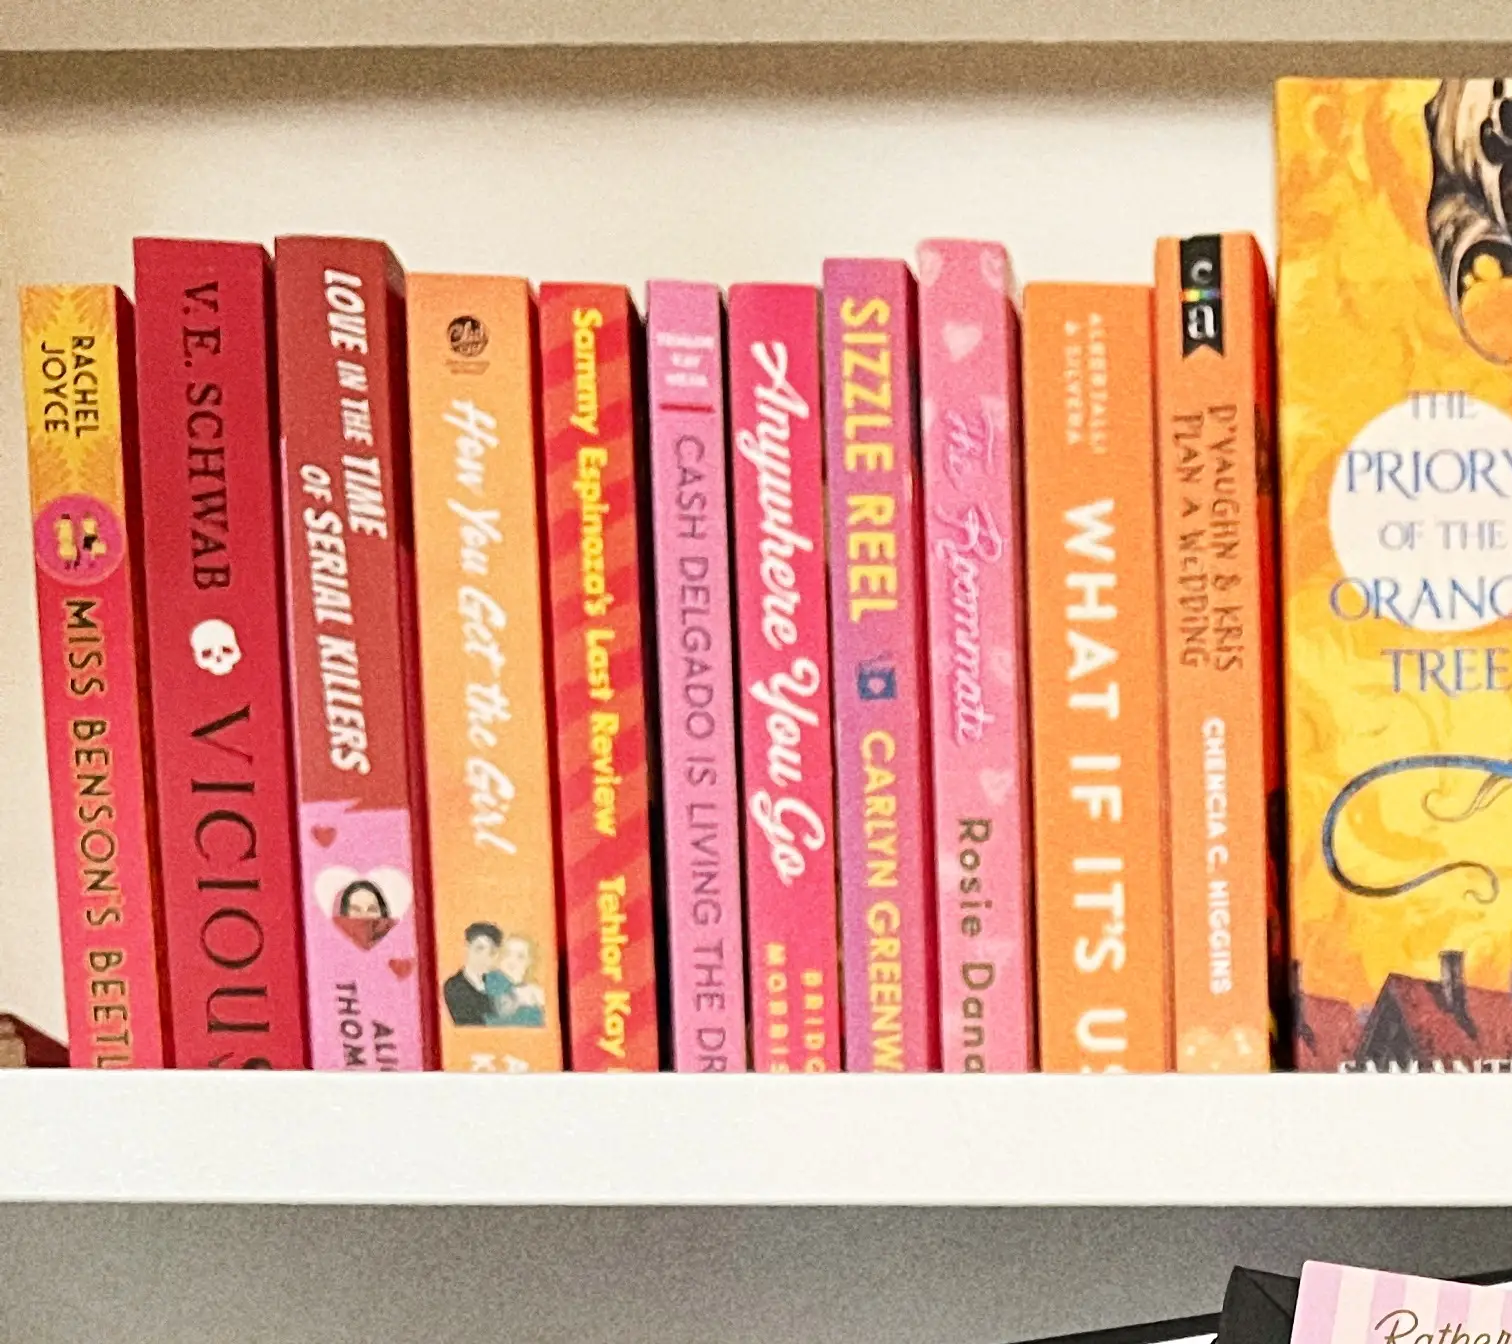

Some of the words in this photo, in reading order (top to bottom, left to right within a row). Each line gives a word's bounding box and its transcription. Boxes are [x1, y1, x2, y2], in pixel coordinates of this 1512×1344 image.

[324, 268, 368, 356] LOVE
[42, 342, 69, 434] JOYCE
[73, 336, 100, 438] RACHEL
[340, 399, 375, 447] THE
[840, 297, 896, 474] SIZZLE
[186, 383, 232, 591] SCHWAB
[300, 464, 333, 504] OF
[343, 456, 388, 540] TIME
[674, 435, 708, 539] CASH
[735, 341, 814, 652] Anywhere
[1379, 519, 1426, 551] OF
[1435, 519, 1508, 551] THE
[303, 508, 356, 626] SERIAL
[845, 494, 900, 625] REEL
[1064, 497, 1120, 720] WHAT
[66, 600, 105, 696] MISS
[585, 629, 616, 701] Last
[678, 557, 715, 741] DELGADO
[1379, 647, 1512, 695] TREE
[316, 634, 371, 775] KILLERS
[464, 683, 513, 748] the
[750, 657, 821, 787] You
[587, 713, 624, 837] Review
[686, 757, 718, 788] IS
[860, 731, 900, 889] CARLYN
[1068, 756, 1123, 822] IF
[687, 805, 723, 927] LIVING
[750, 790, 827, 888] Go
[959, 818, 993, 938] Rosie
[694, 939, 725, 1012] THE
